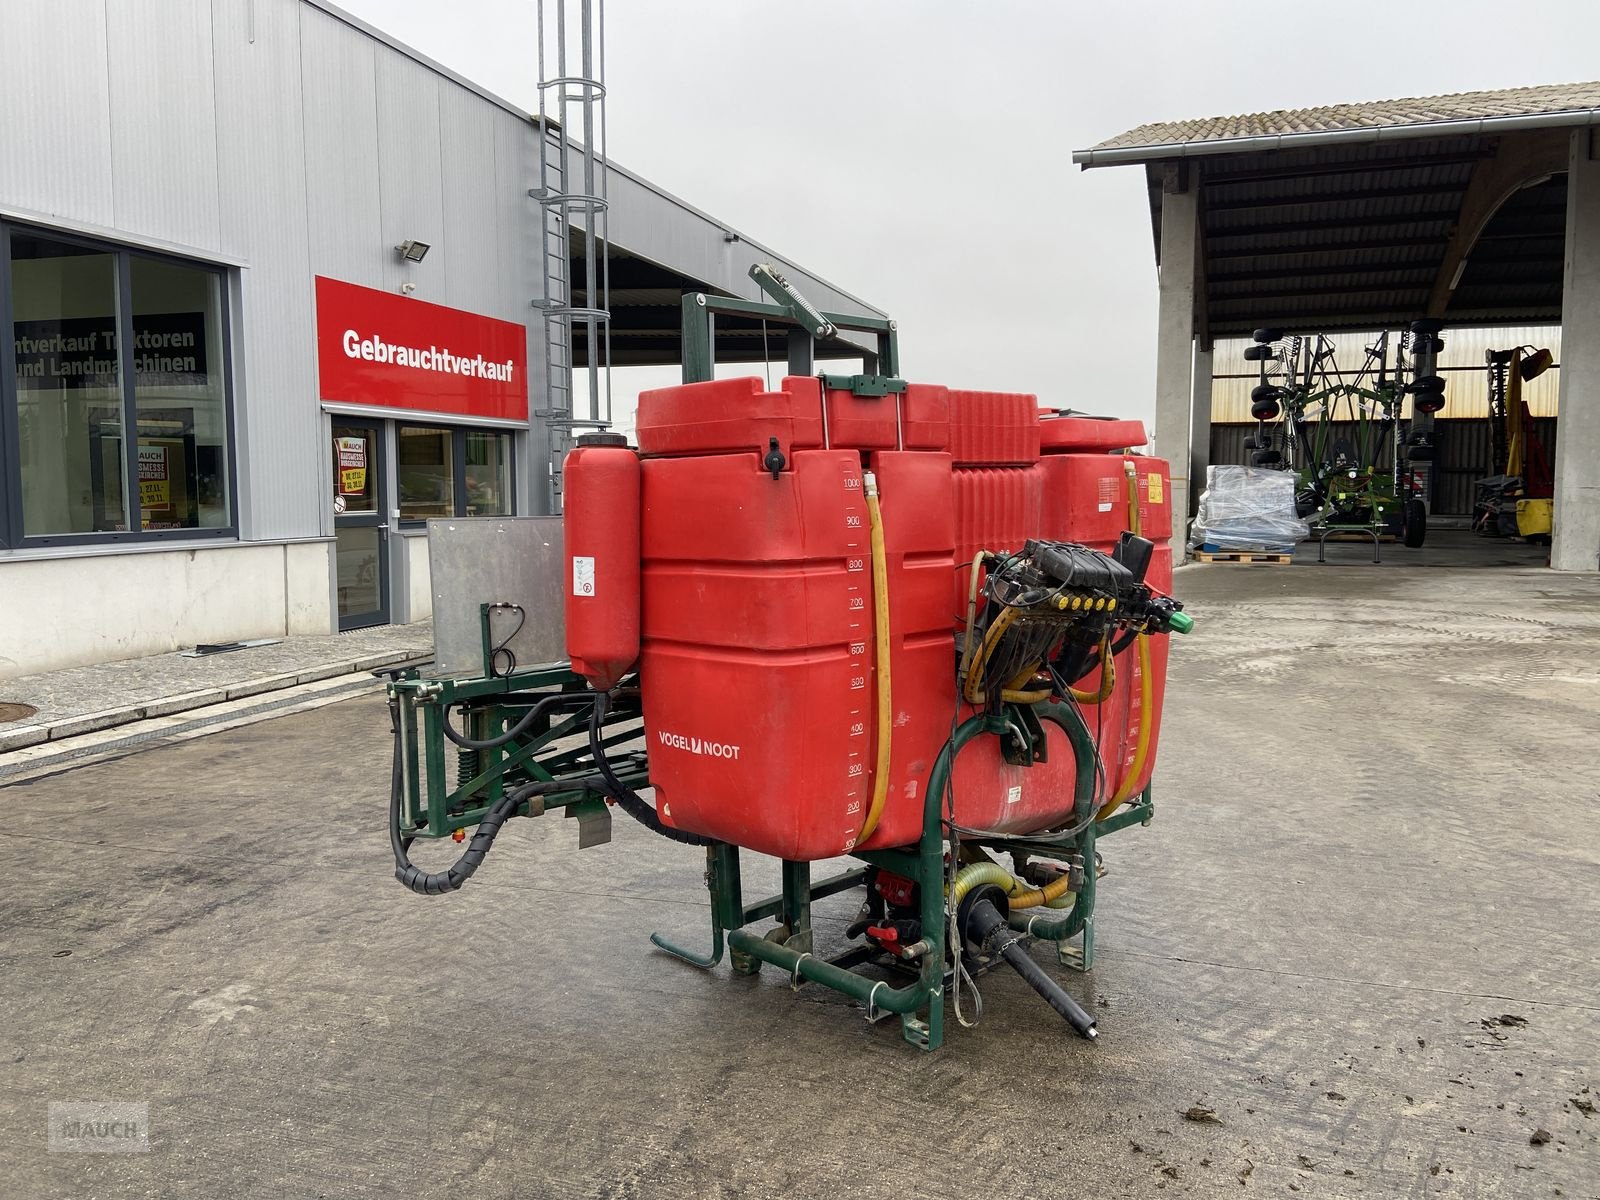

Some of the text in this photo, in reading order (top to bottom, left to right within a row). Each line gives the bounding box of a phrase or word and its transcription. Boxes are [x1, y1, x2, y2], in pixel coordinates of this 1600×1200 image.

[102, 330, 194, 350] Tktoren
[343, 329, 513, 382] Gebrauchtverkauf
[51, 353, 196, 376] Landmachinen
[139, 452, 162, 460] AUCH
[844, 478, 861, 488] 1000
[846, 516, 860, 525] 900
[848, 560, 863, 569] 800
[849, 598, 864, 607] 700
[851, 646, 865, 655] 600
[851, 676, 865, 686] 500
[850, 723, 864, 733] 400
[659, 731, 740, 760] VOGEL NOOT
[848, 763, 862, 774] 300
[847, 800, 860, 812] 200
